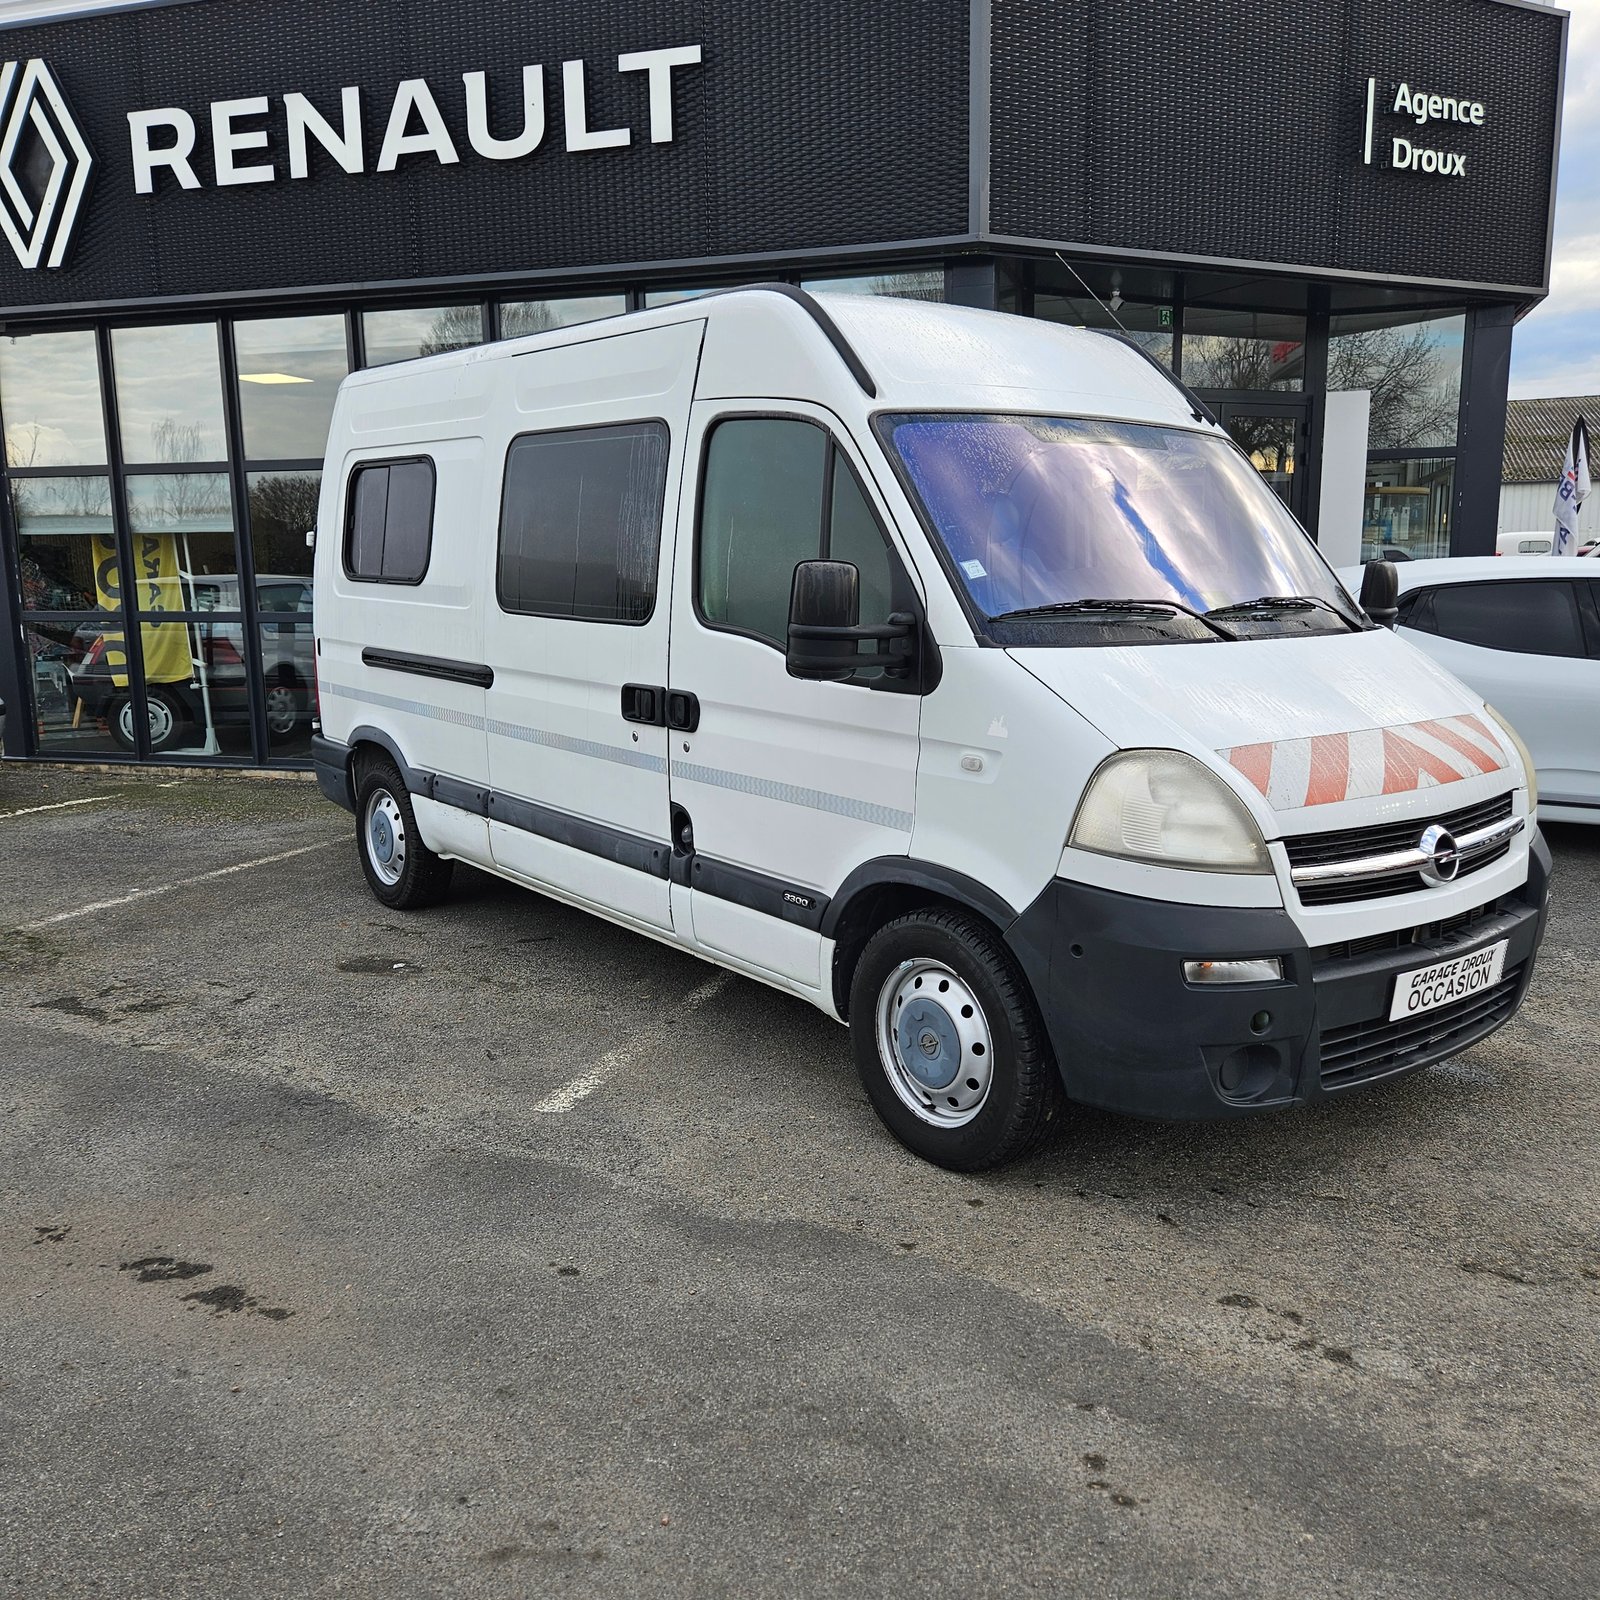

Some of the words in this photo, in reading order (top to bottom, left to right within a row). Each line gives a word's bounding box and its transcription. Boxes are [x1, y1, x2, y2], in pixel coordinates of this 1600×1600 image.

[127, 44, 703, 195] RENAULT
[1393, 83, 1484, 125] Agence
[1392, 137, 1466, 177] Droux
[784, 893, 808, 906] 3300
[1408, 965, 1491, 1011] OCCASION
[1411, 962, 1460, 988] GARAGE
[1461, 949, 1497, 973] DROUX
